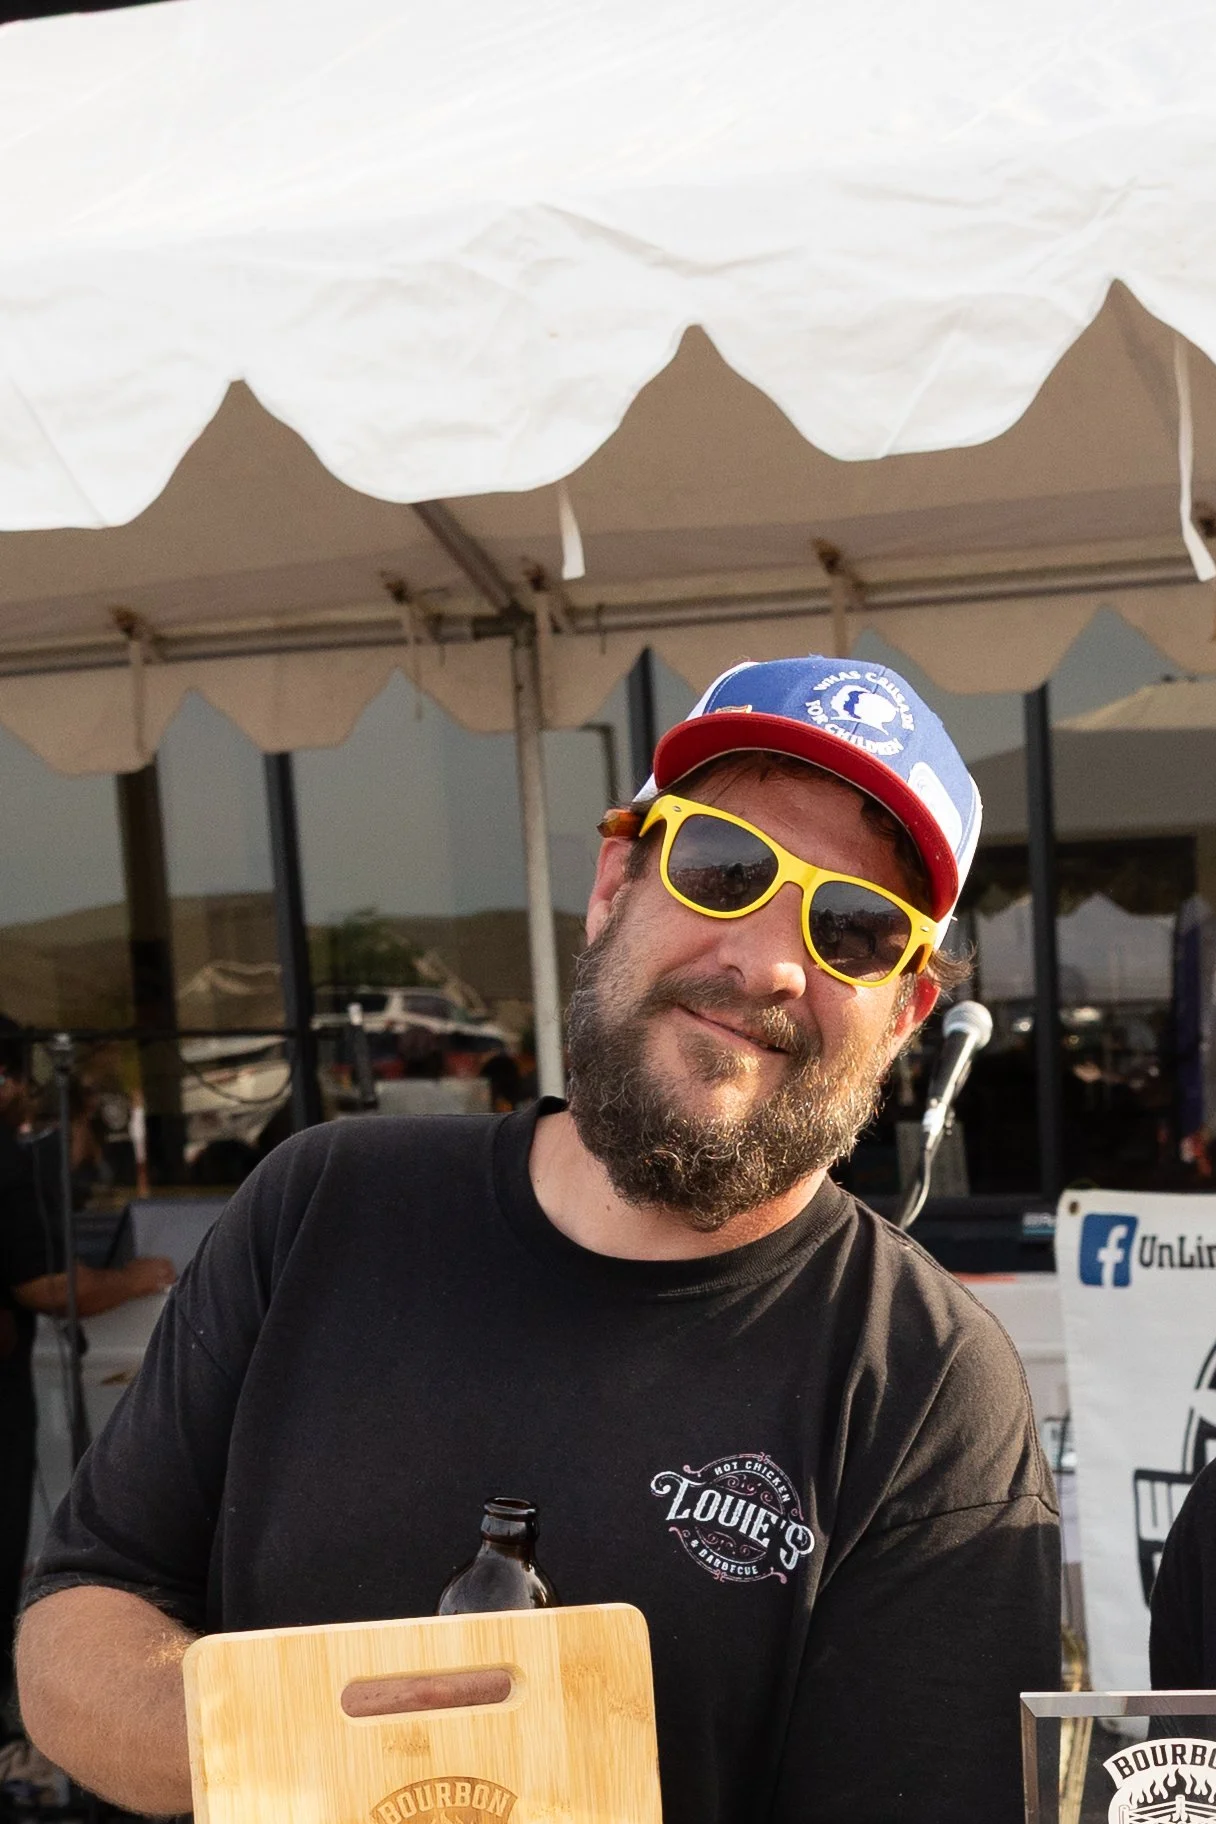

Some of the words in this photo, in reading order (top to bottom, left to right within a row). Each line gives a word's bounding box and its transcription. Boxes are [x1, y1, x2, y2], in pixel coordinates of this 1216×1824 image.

[813, 670, 861, 690] WHAS
[805, 700, 829, 725] FOR
[825, 723, 904, 756] CHILDREN
[714, 1461, 739, 1477] HOT
[745, 1460, 792, 1503] CHICKEN
[650, 1471, 815, 1570] LOUIE'S
[690, 1540, 699, 1549] &
[698, 1549, 759, 1576] BARBECUE
